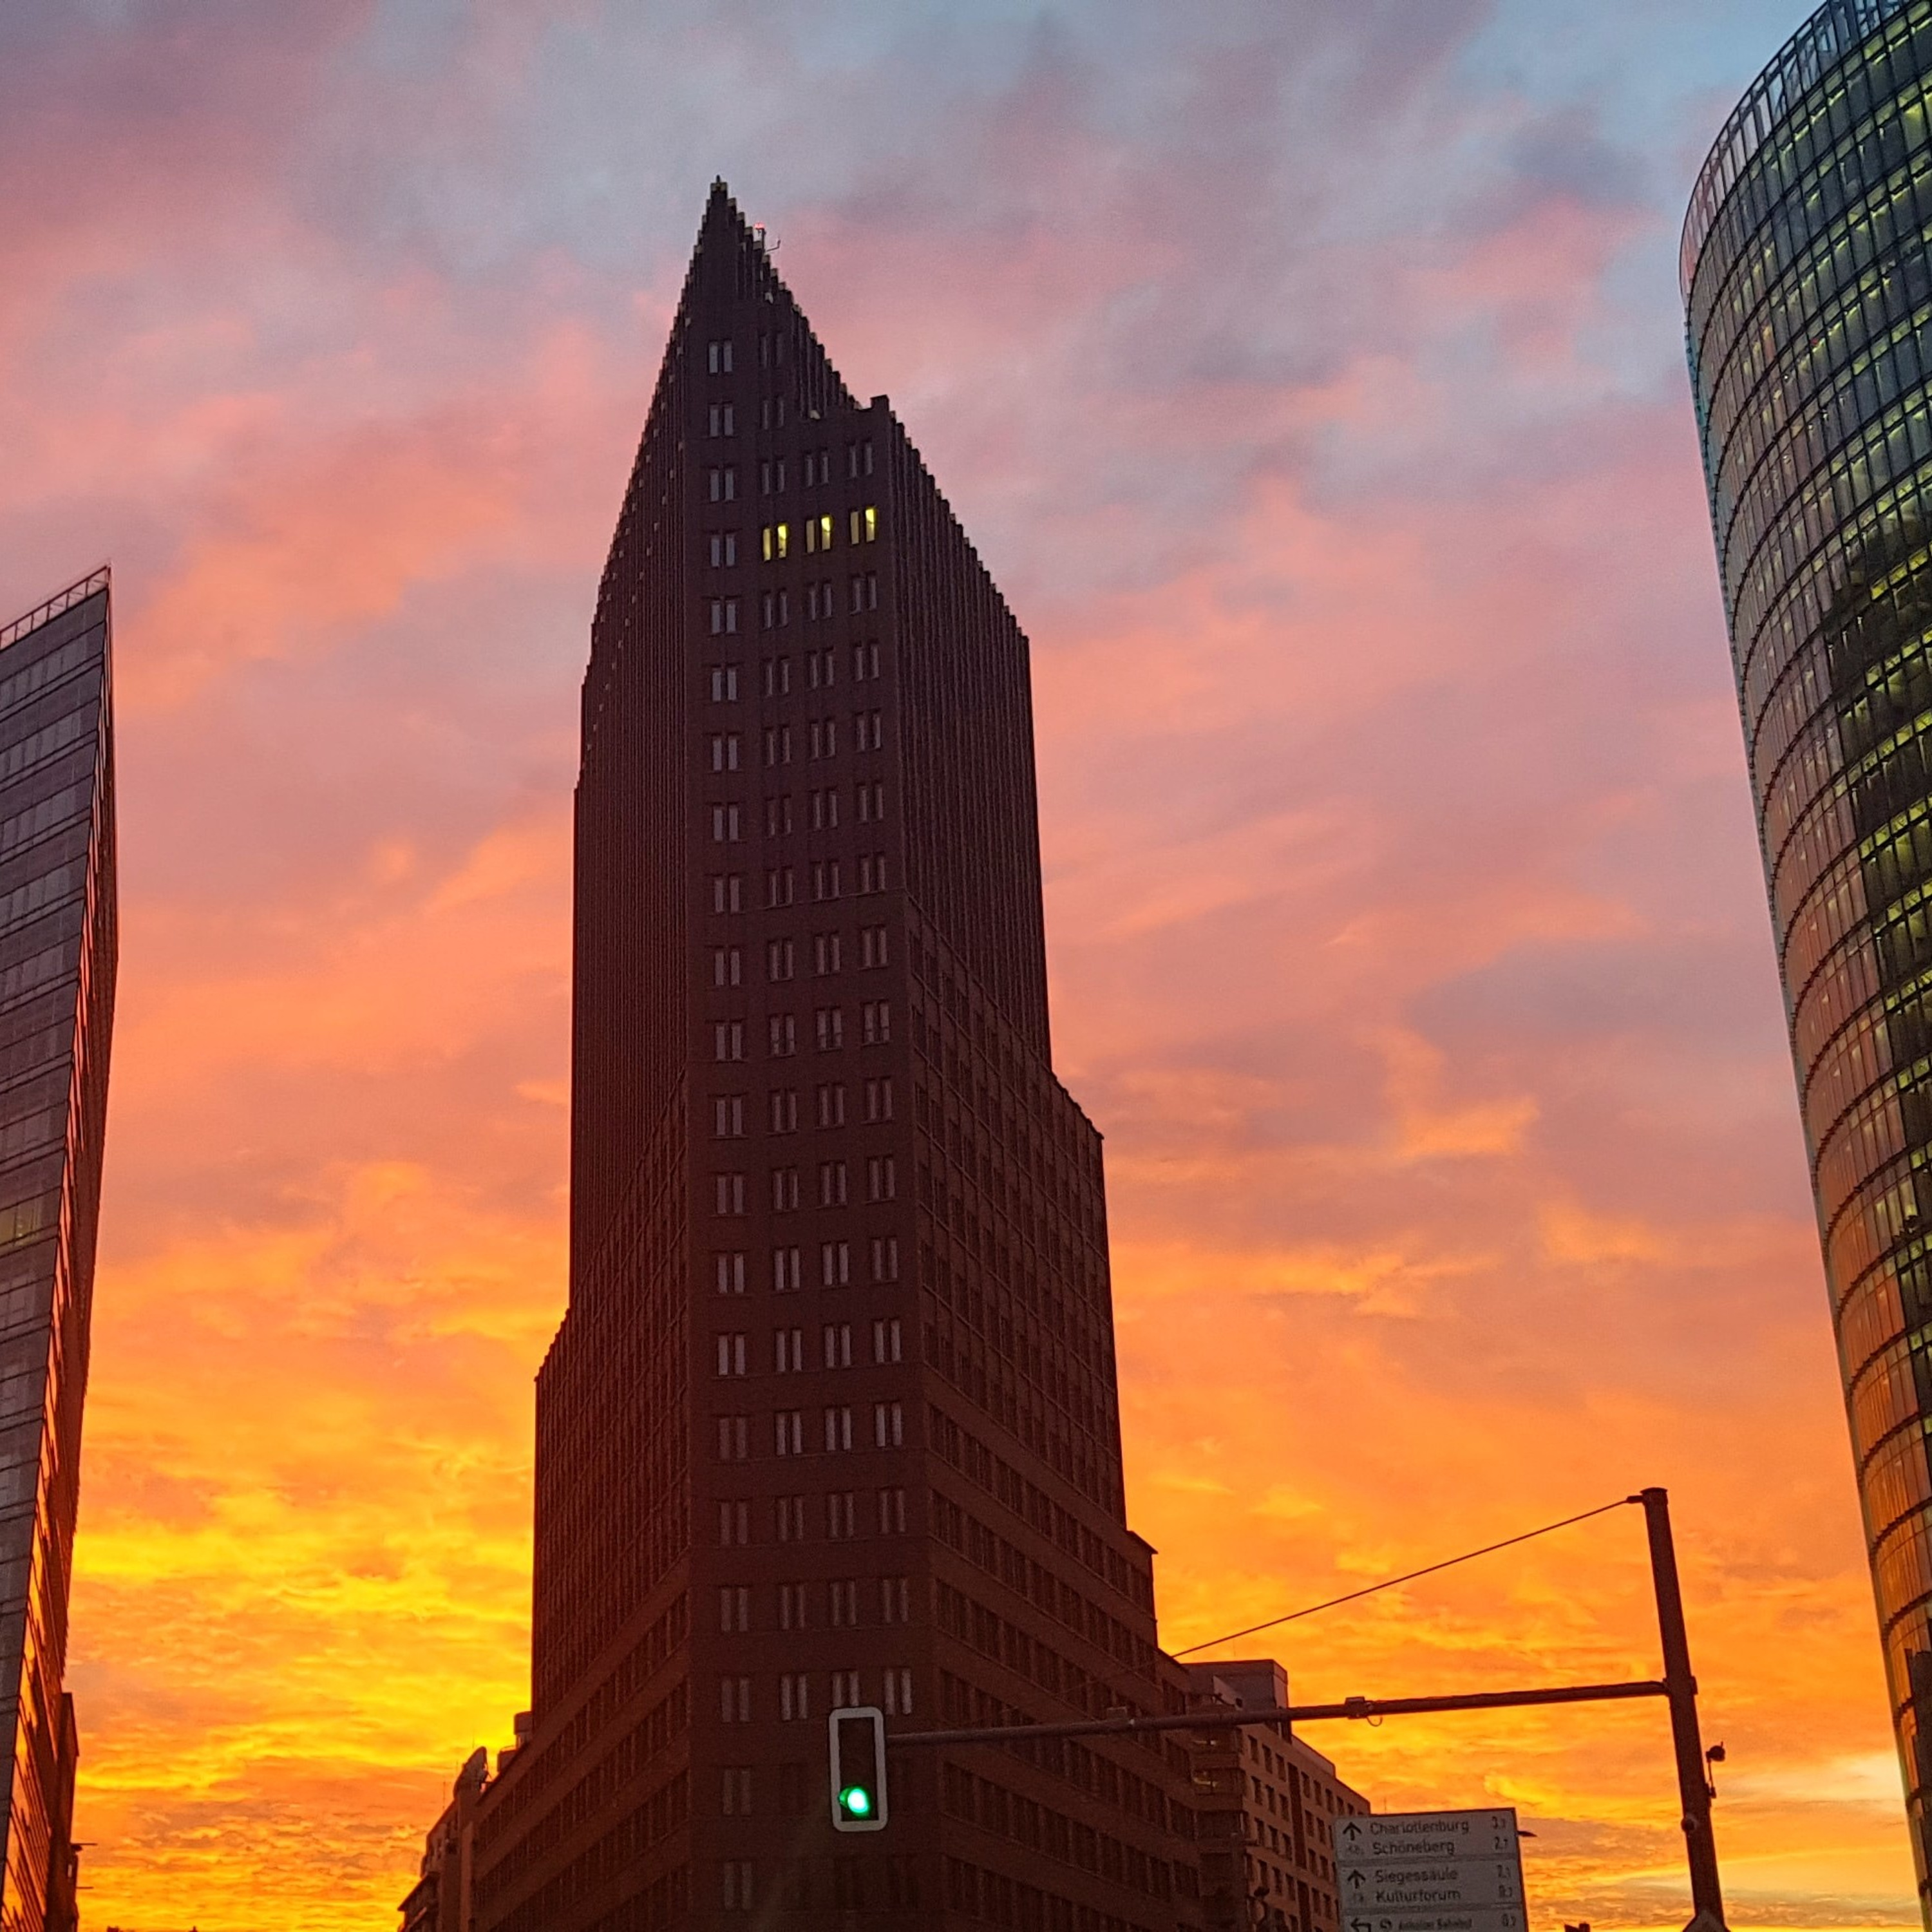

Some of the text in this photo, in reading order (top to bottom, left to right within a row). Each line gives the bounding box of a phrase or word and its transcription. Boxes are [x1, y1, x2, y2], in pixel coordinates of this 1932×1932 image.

[1370, 1818, 1470, 1835] Charlottenburg
[1372, 1838, 1455, 1855] Schöneberg
[1374, 1866, 1459, 1884] Siegessäule
[1375, 1889, 1461, 1904] Kulturforum
